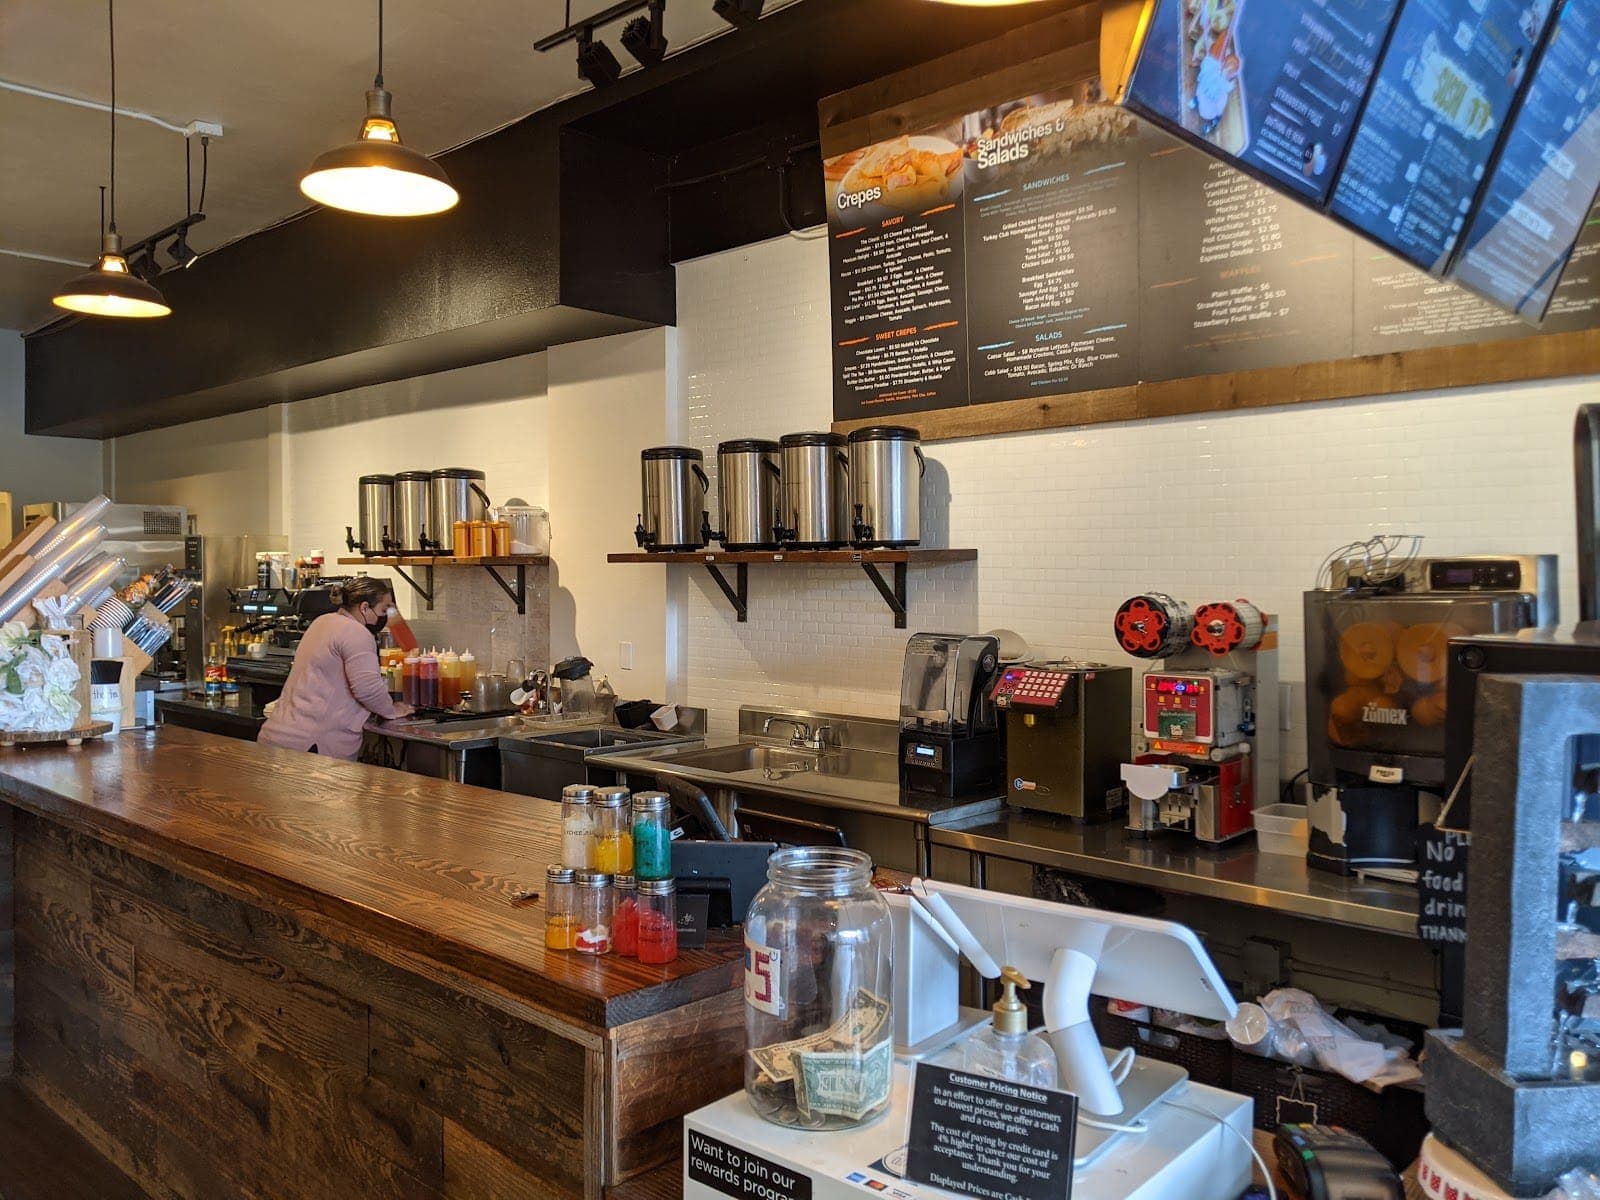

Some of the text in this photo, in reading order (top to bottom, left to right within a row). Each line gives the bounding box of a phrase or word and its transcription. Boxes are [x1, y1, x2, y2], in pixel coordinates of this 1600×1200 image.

[977, 122, 1052, 153] Sandwiches
[977, 143, 1029, 169] Salads
[1023, 173, 1070, 191] SANDWICHES
[1203, 178, 1229, 189] Caramel
[1230, 184, 1248, 193] Latte
[837, 186, 881, 209] Crepes
[1216, 205, 1238, 214] Mocha
[1217, 229, 1250, 241] Chocolate
[876, 327, 917, 340] SWEET CREPES
[1035, 330, 1062, 342] SALADS
[1362, 702, 1407, 725] zümex
[1426, 840, 1455, 862] No
[1421, 869, 1464, 892] food
[1424, 897, 1466, 918] drin
[949, 1073, 1047, 1102] Customer Pricing Notice
[934, 1086, 941, 1095] In
[953, 1091, 974, 1103] effort
[976, 1096, 984, 1105] to
[985, 1098, 1003, 1109] offer
[1005, 1104, 1018, 1112] our
[1020, 1108, 1061, 1122] customers
[934, 1098, 947, 1106] our
[948, 1099, 972, 1112] lowest
[974, 1107, 999, 1121] prices,
[1001, 1113, 1012, 1121] we
[1014, 1115, 1032, 1126] offer
[1041, 1122, 1059, 1132] cash
[960, 1114, 975, 1123] and
[983, 1119, 1005, 1130] credit
[1006, 1125, 1028, 1136] price.
[931, 1121, 1058, 1160] The cost of paying by credit card is
[950, 1136, 974, 1150] higher
[976, 1143, 983, 1152] to
[985, 1148, 1005, 1157] cover
[1006, 1153, 1020, 1161] our
[1022, 1157, 1038, 1165] cost
[1039, 1159, 1049, 1168] of
[691, 1134, 796, 1190] Want to join our
[933, 1145, 1050, 1179] acceptance. Thank you for your
[962, 1162, 1018, 1184] understanding.
[691, 1156, 795, 1200] rewards progra
[930, 1173, 966, 1190] Displayed
[967, 1183, 990, 1196] Prices
[991, 1191, 1003, 1199] are
